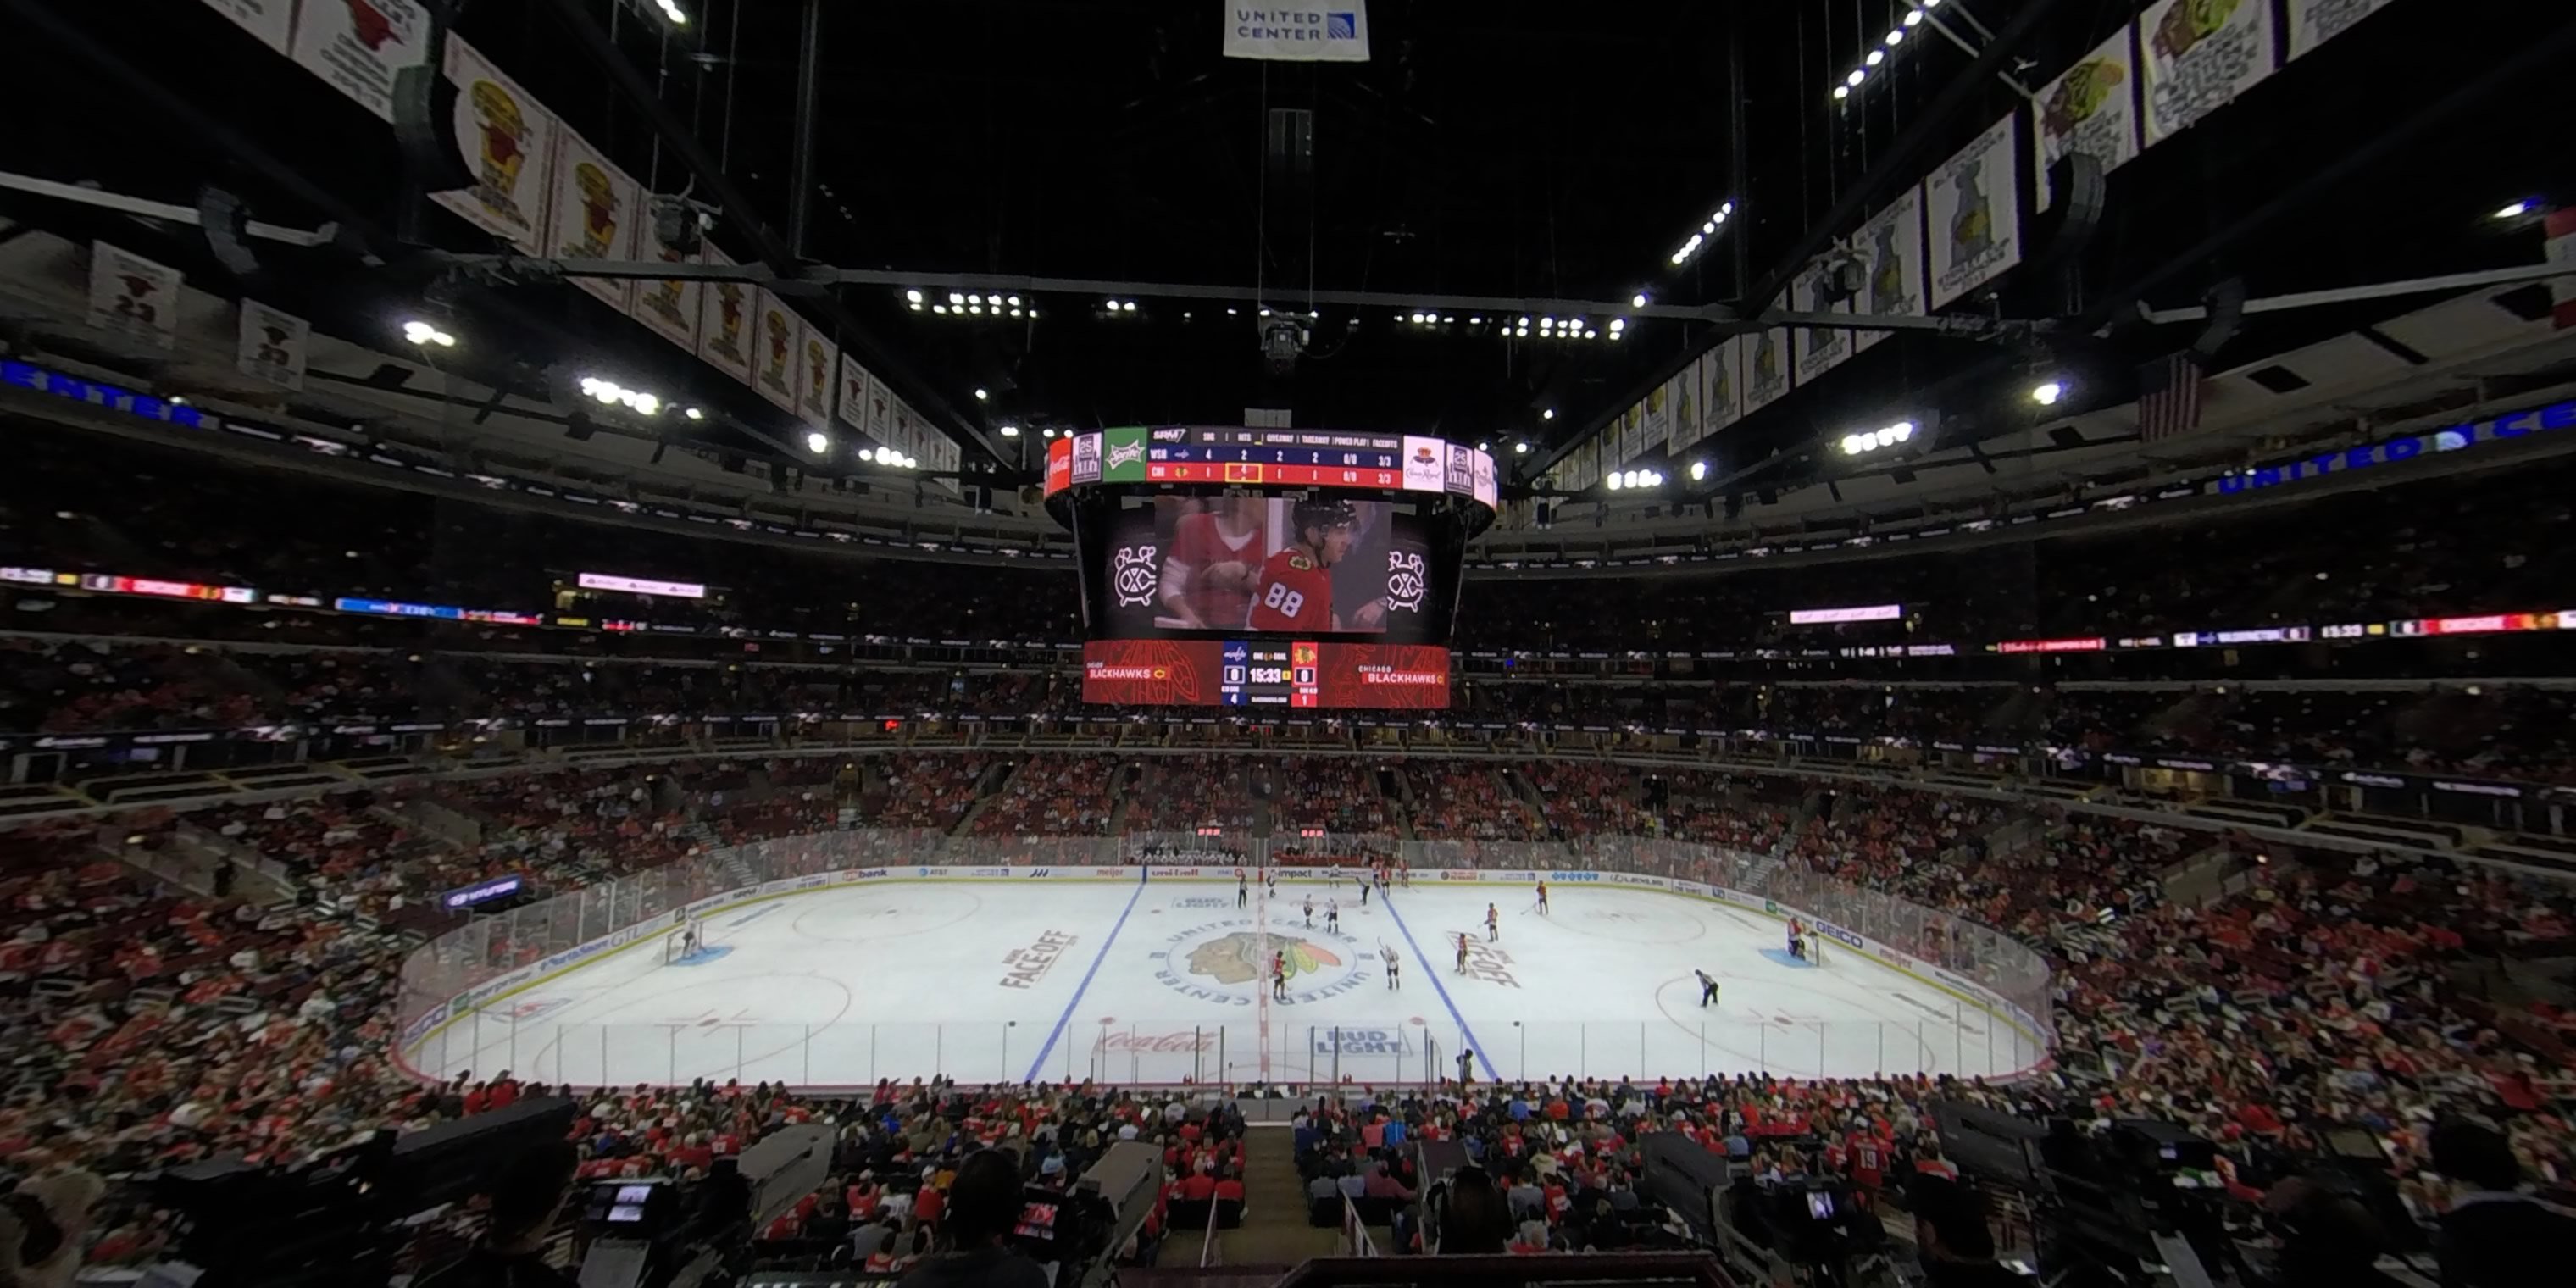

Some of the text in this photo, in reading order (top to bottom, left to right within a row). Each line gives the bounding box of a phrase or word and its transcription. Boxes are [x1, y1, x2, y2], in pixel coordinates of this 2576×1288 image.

[1237, 10, 1321, 24] UNITED
[1237, 26, 1321, 41] CENTER
[115, 294, 155, 323] 23
[1080, 441, 1092, 453] 25
[1110, 447, 1139, 463] Sprite
[1150, 448, 1167, 459] WSH
[1206, 448, 1212, 459] 4
[1241, 450, 1247, 460] 2
[1277, 451, 1283, 462] 2
[1313, 452, 1319, 464] 2
[1379, 455, 1391, 467] 3/3
[1454, 451, 1466, 465] 25
[2218, 436, 2423, 496] UNITED
[1152, 466, 1165, 477] CHI
[1378, 472, 1391, 484] 3/3
[1264, 581, 1304, 618] 88
[1090, 669, 1151, 679] BLACKHAWKS
[1231, 669, 1238, 681] 0
[1249, 668, 1281, 684] 15:33
[1301, 669, 1308, 682] 0
[1357, 664, 1392, 674] CHICAGO
[1368, 673, 1436, 684] BLACKHAWKS
[1230, 694, 1237, 704] 4
[1302, 695, 1307, 706] 1
[1096, 868, 1124, 878] meijer
[1624, 873, 1664, 886] LEXUS
[1167, 919, 1252, 943] UNITED
[1815, 920, 1863, 949] GEICO
[999, 930, 1069, 989] FACE-OFF
[1154, 970, 1252, 1007] CENTER
[1099, 1031, 1219, 1052] Coca-Cola
[1326, 1030, 1387, 1042] BUD
